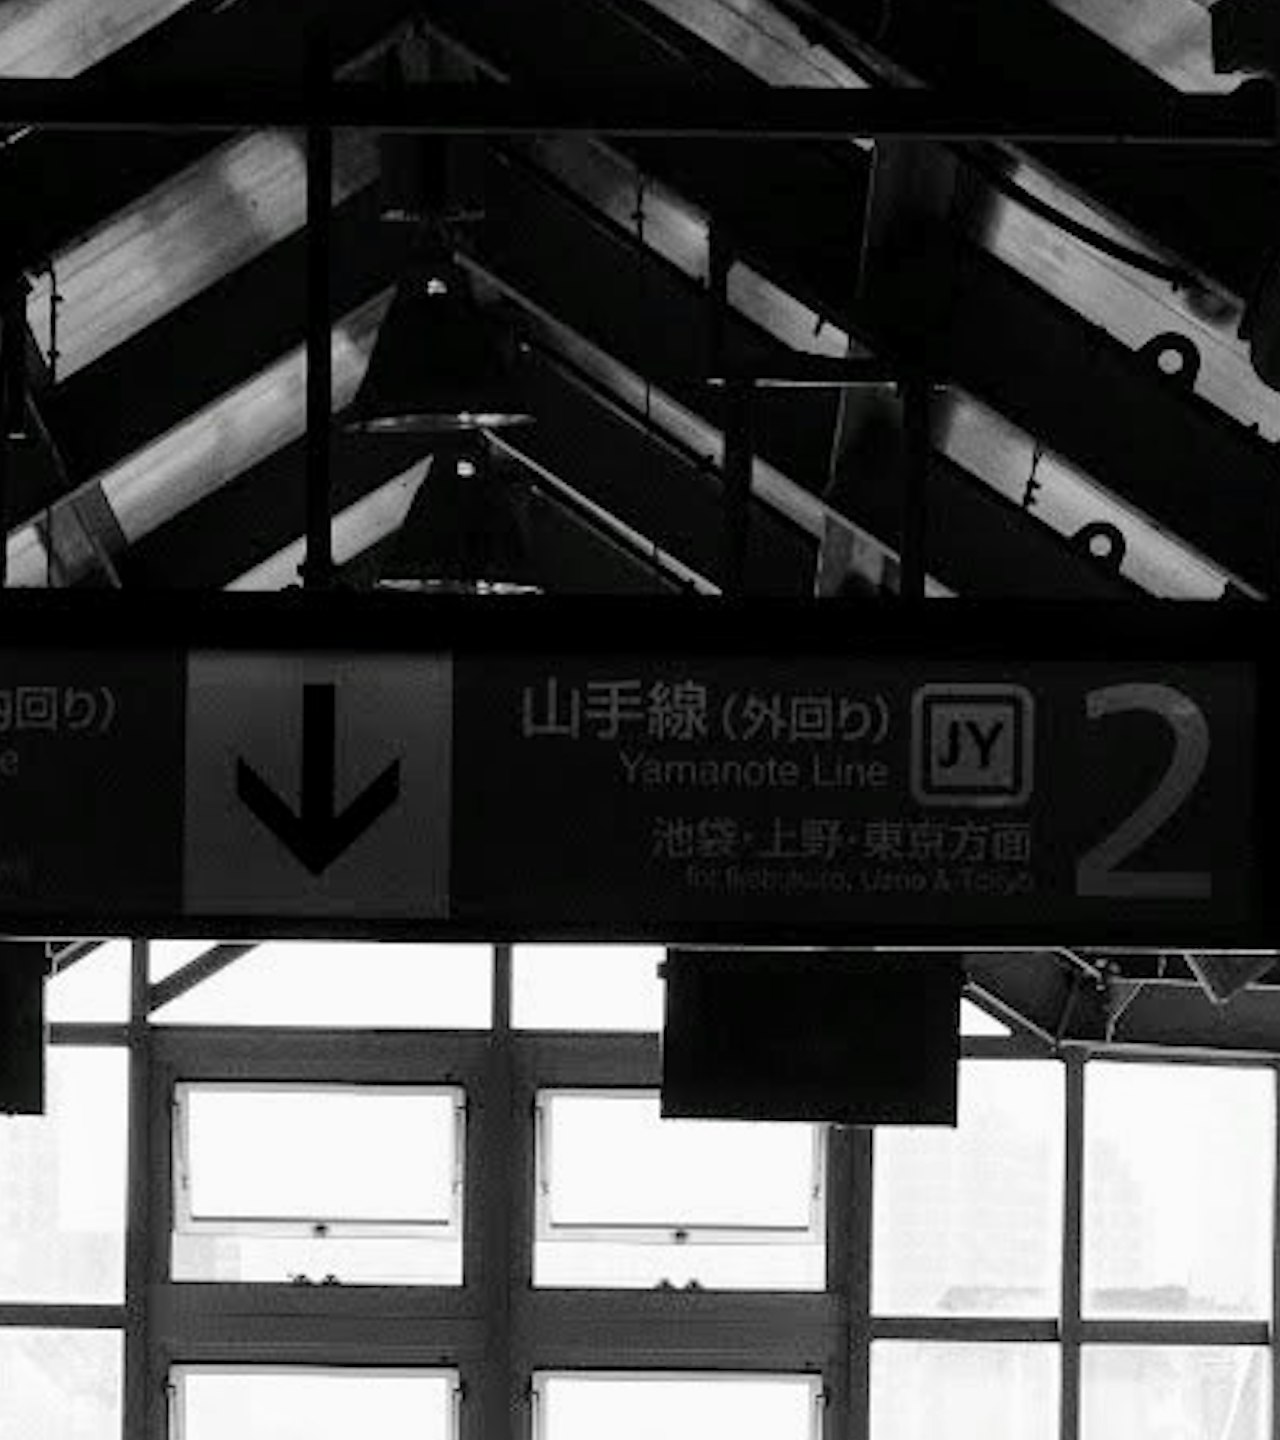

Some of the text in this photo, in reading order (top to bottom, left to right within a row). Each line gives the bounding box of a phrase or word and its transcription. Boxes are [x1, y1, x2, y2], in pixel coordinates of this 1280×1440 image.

[937, 721, 1004, 769] JY
[618, 753, 890, 790] Yamanote Line
[1076, 682, 1212, 898] 2
